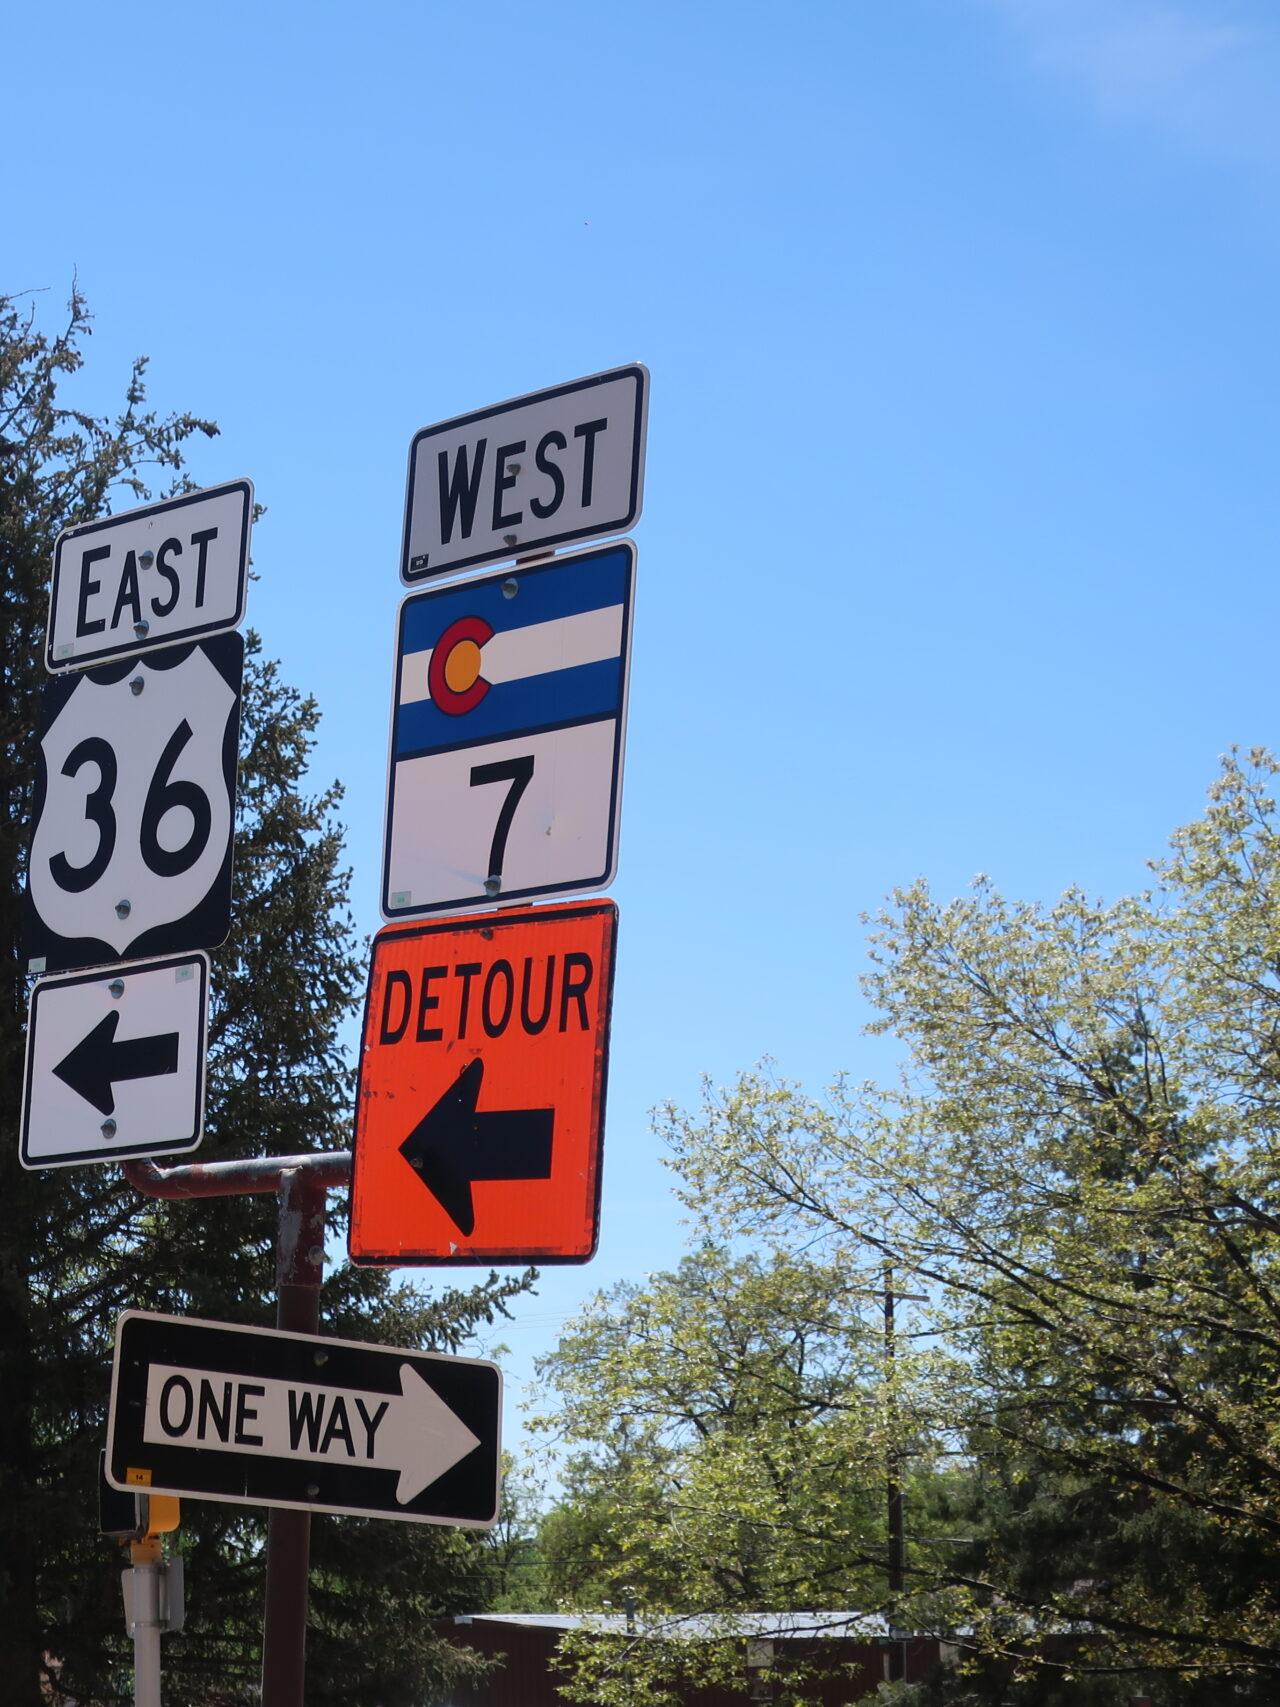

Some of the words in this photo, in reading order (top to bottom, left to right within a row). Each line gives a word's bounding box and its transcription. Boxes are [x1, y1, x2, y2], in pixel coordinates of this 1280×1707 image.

[438, 418, 607, 545] WEST
[76, 527, 218, 638] EAST
[49, 718, 211, 893] 36
[469, 755, 535, 891] 7
[380, 952, 594, 1045] DETOUR
[160, 1375, 265, 1446] ONE
[288, 1390, 389, 1459] WAY
